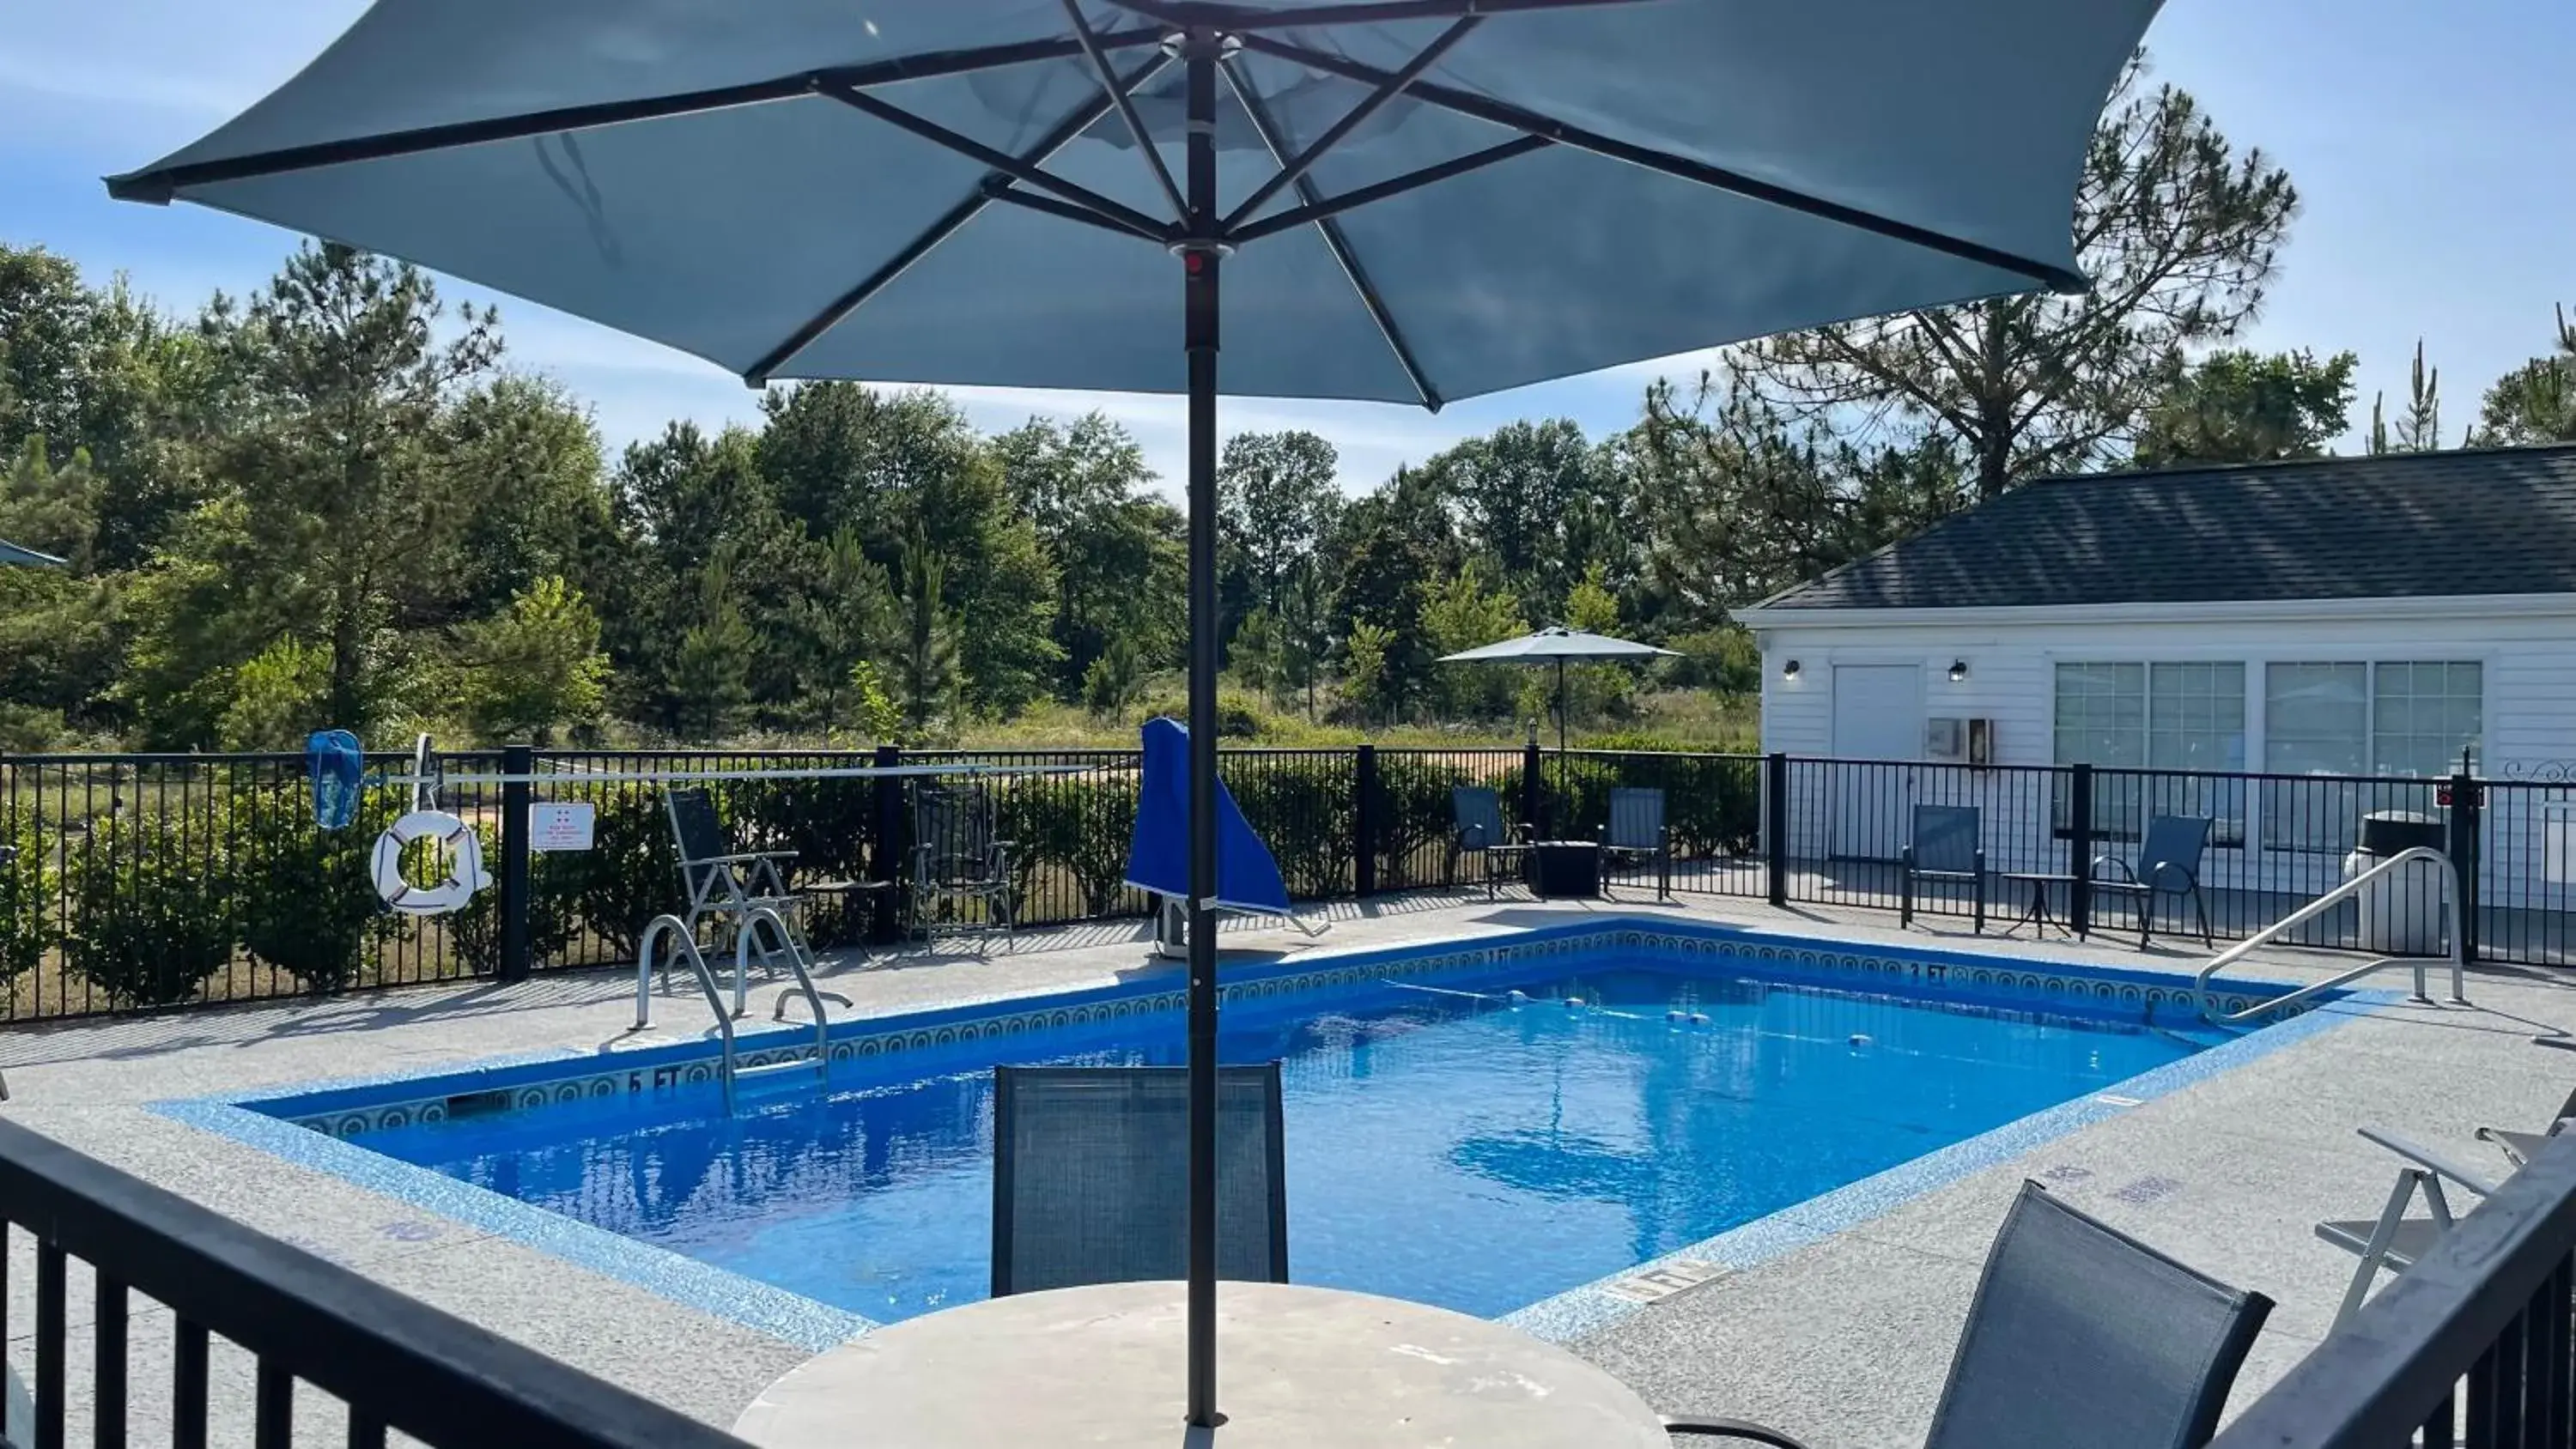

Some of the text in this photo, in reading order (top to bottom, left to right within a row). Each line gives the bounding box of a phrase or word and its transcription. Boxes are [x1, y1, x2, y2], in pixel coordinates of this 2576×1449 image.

[1928, 963, 1947, 979] FT
[653, 1066, 682, 1088] FT
[1637, 1268, 1698, 1289] FT
